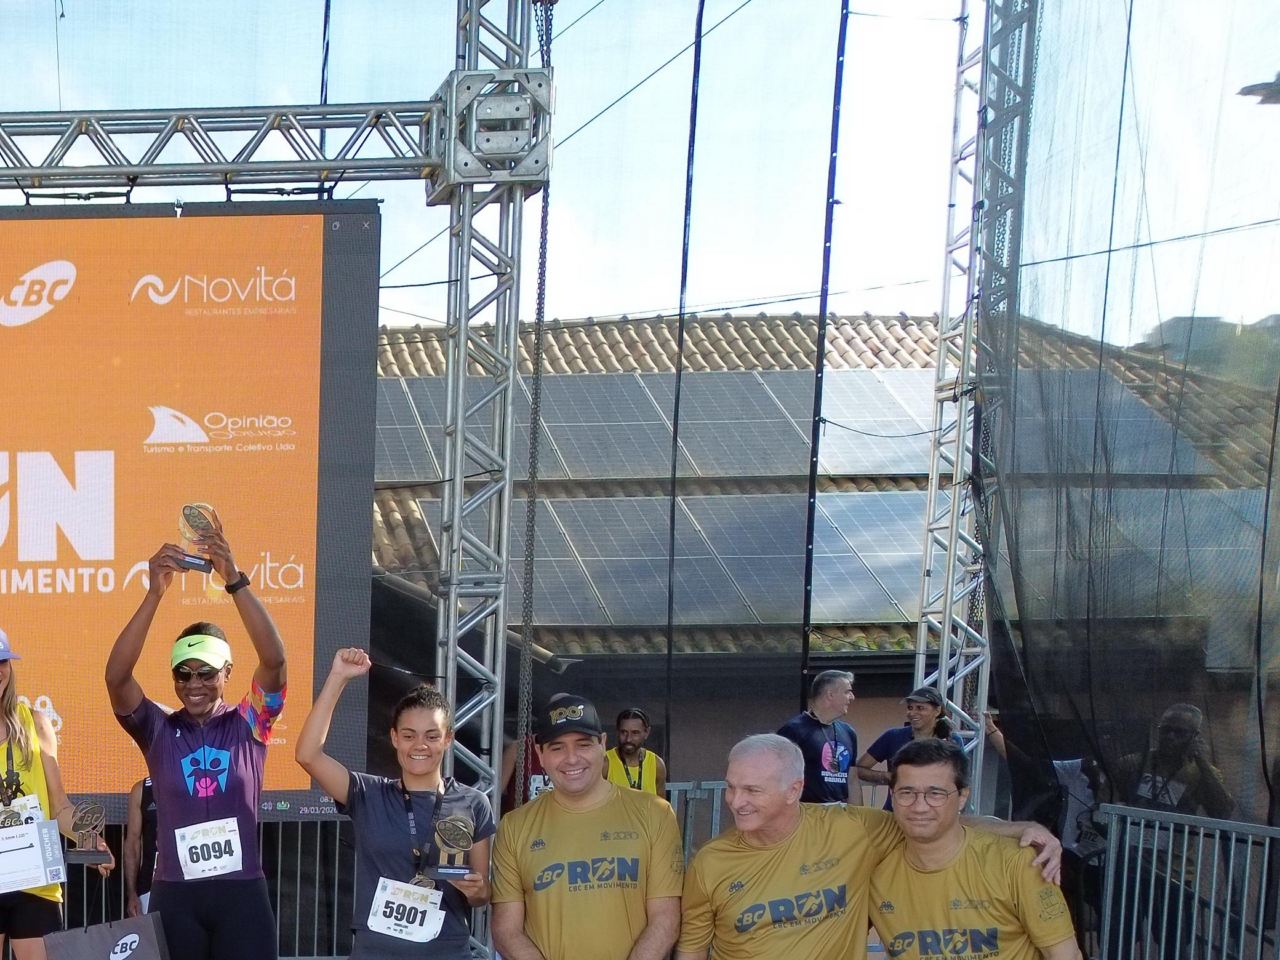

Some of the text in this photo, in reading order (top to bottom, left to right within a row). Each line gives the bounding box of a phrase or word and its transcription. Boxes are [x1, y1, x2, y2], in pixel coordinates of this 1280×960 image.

[184, 266, 296, 303] Novitá
[204, 411, 292, 431] Opinião
[143, 444, 175, 453] Turismo
[186, 444, 233, 453] Transporte
[235, 443, 273, 452] Coletivo
[275, 443, 296, 451] Ltda
[181, 595, 306, 605] RESTAURANT PRESARIAIS
[42, 827, 53, 863] VOUCHER
[188, 839, 235, 864] 6094
[535, 857, 640, 885] CBC RUN
[382, 900, 428, 927] 5901
[768, 884, 847, 924] RUN
[917, 927, 999, 956] RUN
